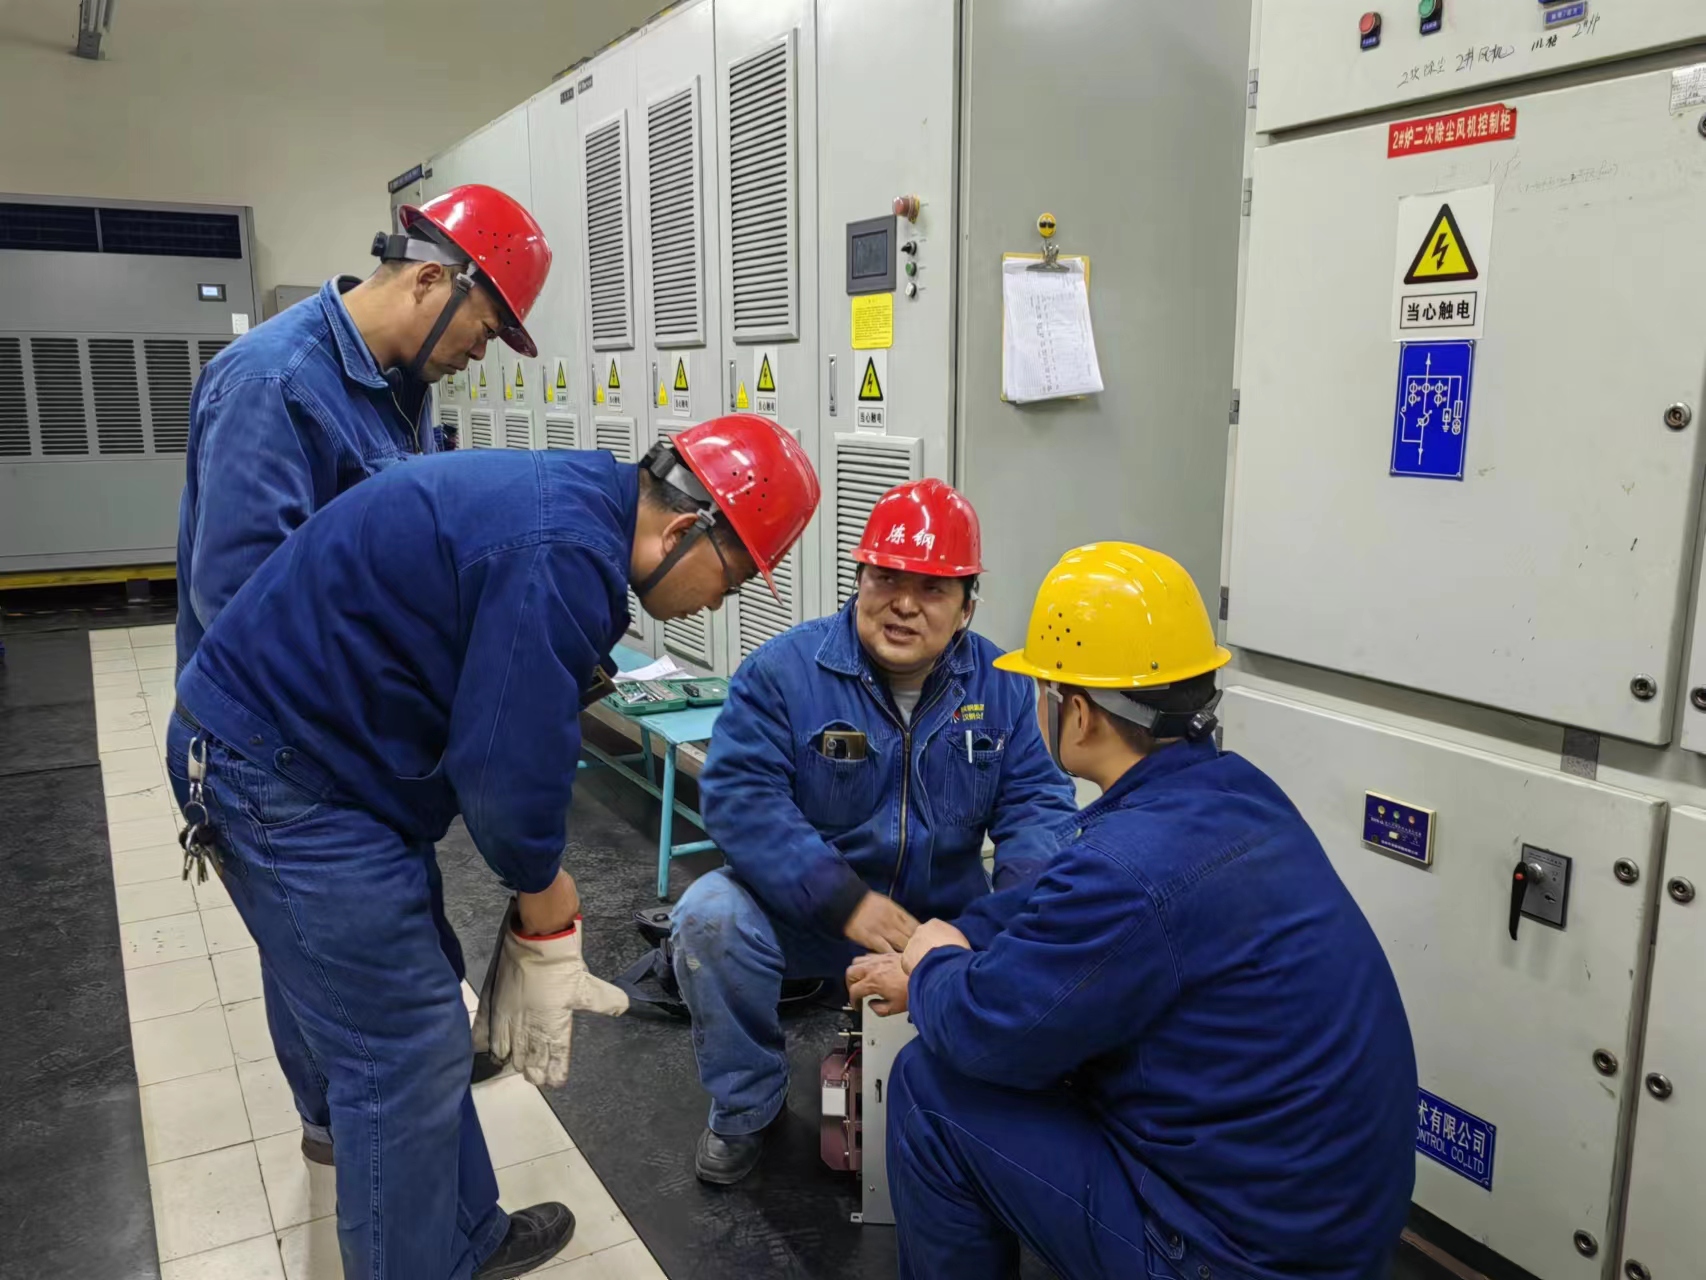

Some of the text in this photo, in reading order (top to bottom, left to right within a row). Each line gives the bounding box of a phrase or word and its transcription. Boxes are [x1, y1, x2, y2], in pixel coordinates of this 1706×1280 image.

[1392, 109, 1511, 150] 2#炉二次除尘风机控制柜
[1406, 300, 1471, 321] 当心触电
